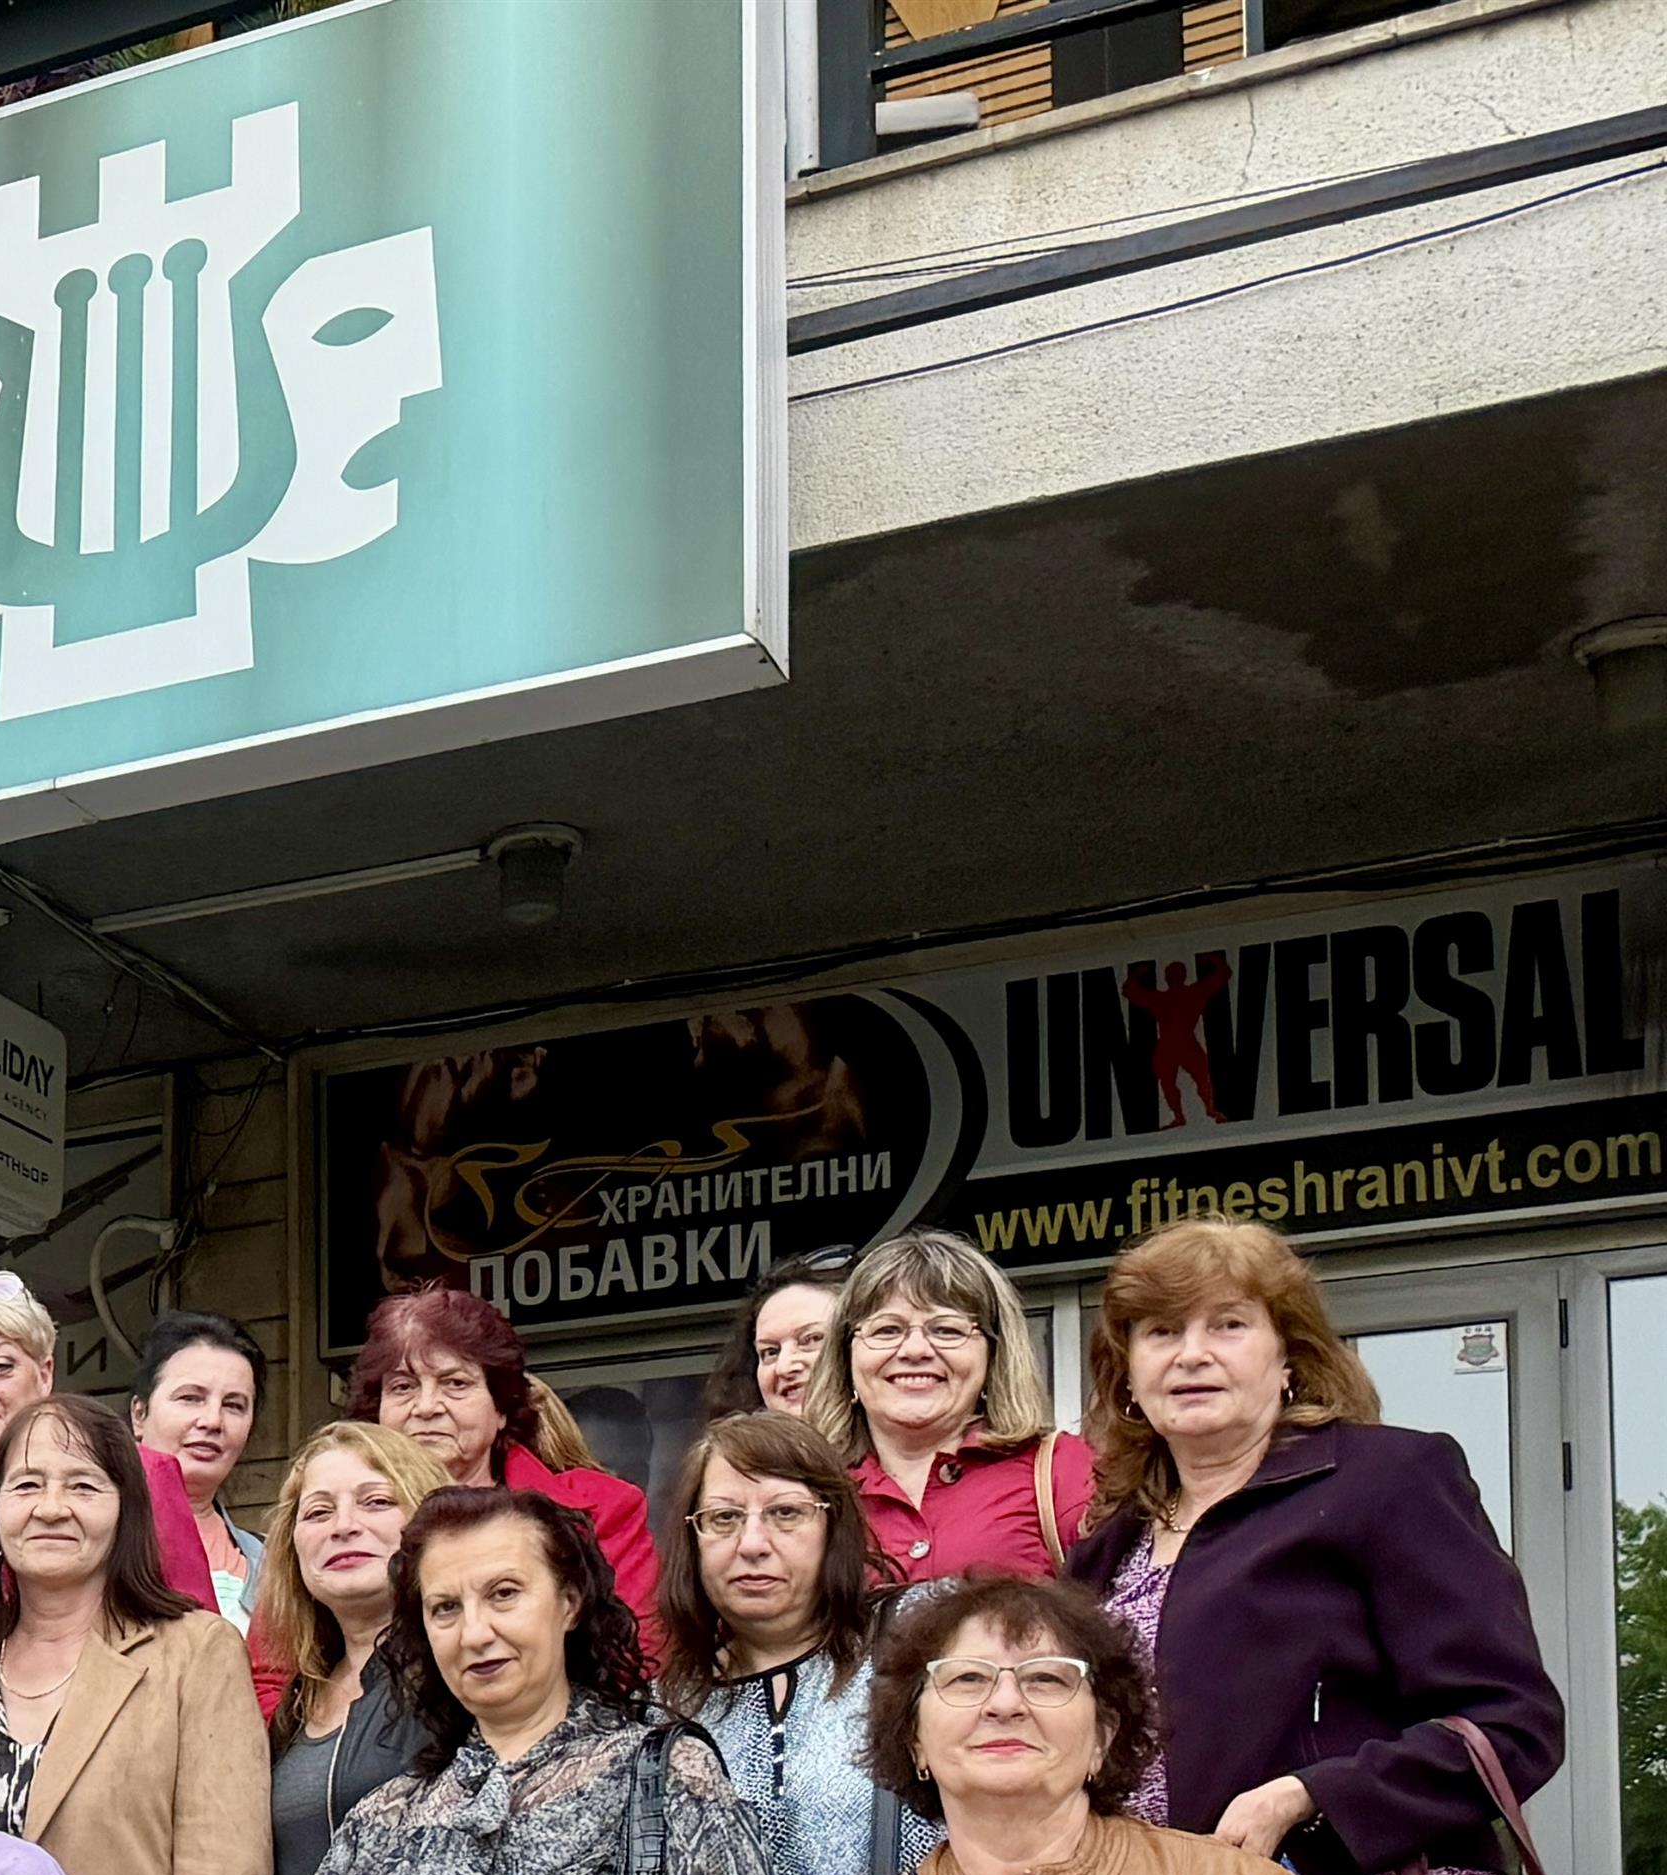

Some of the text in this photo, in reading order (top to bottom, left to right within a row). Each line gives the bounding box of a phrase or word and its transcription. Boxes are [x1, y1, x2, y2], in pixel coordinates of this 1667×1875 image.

[4, 1092, 48, 1121] AGENCY
[597, 1151, 892, 1227] ХРАНИТЕЛНИ
[974, 1130, 1663, 1253] www.fitneshranivt.com
[468, 1220, 772, 1320] ДОБАВКИ
